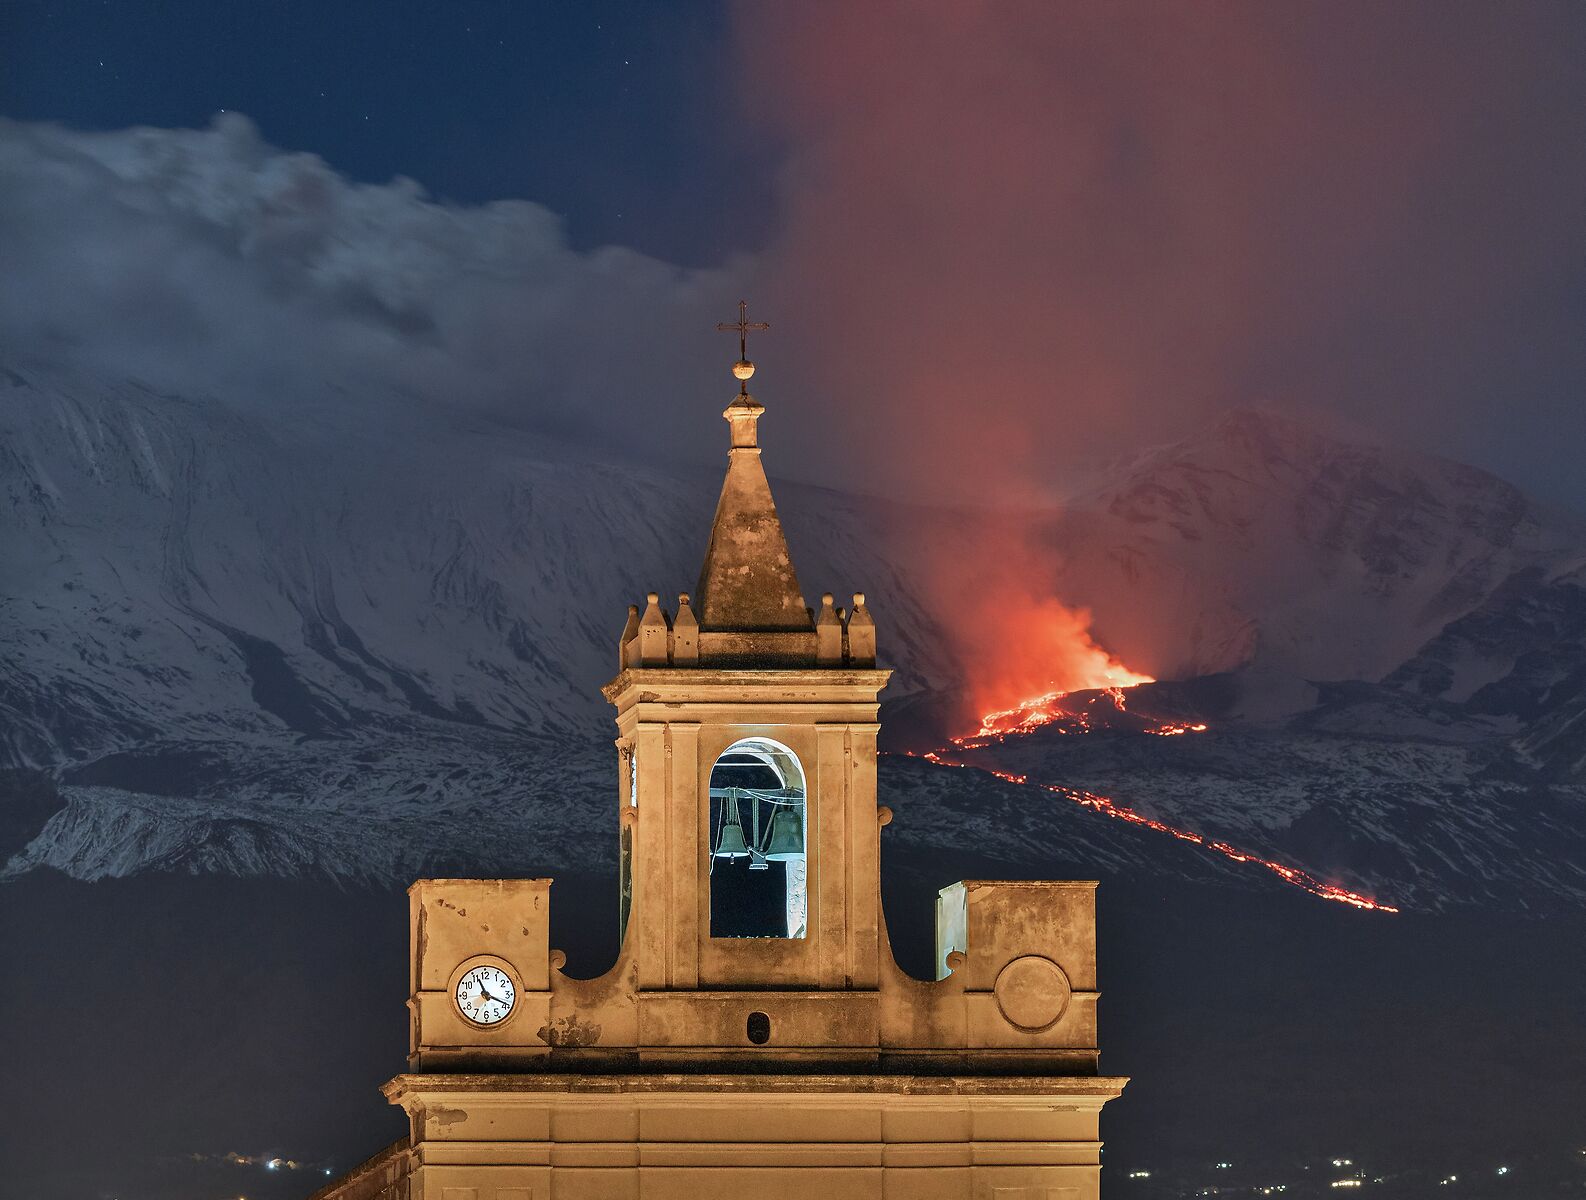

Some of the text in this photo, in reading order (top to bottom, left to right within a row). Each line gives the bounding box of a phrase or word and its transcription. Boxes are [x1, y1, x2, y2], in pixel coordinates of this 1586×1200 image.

[472, 974, 479, 982] 11
[481, 972, 490, 980] 12
[465, 981, 472, 989] 10
[500, 980, 506, 988] 2
[462, 991, 468, 1000] 9
[505, 990, 510, 999] 3
[467, 1002, 472, 1010] 8
[502, 1002, 508, 1010] 4
[474, 1008, 479, 1017] 7
[484, 1010, 489, 1019] 6
[494, 1008, 499, 1016] 5
